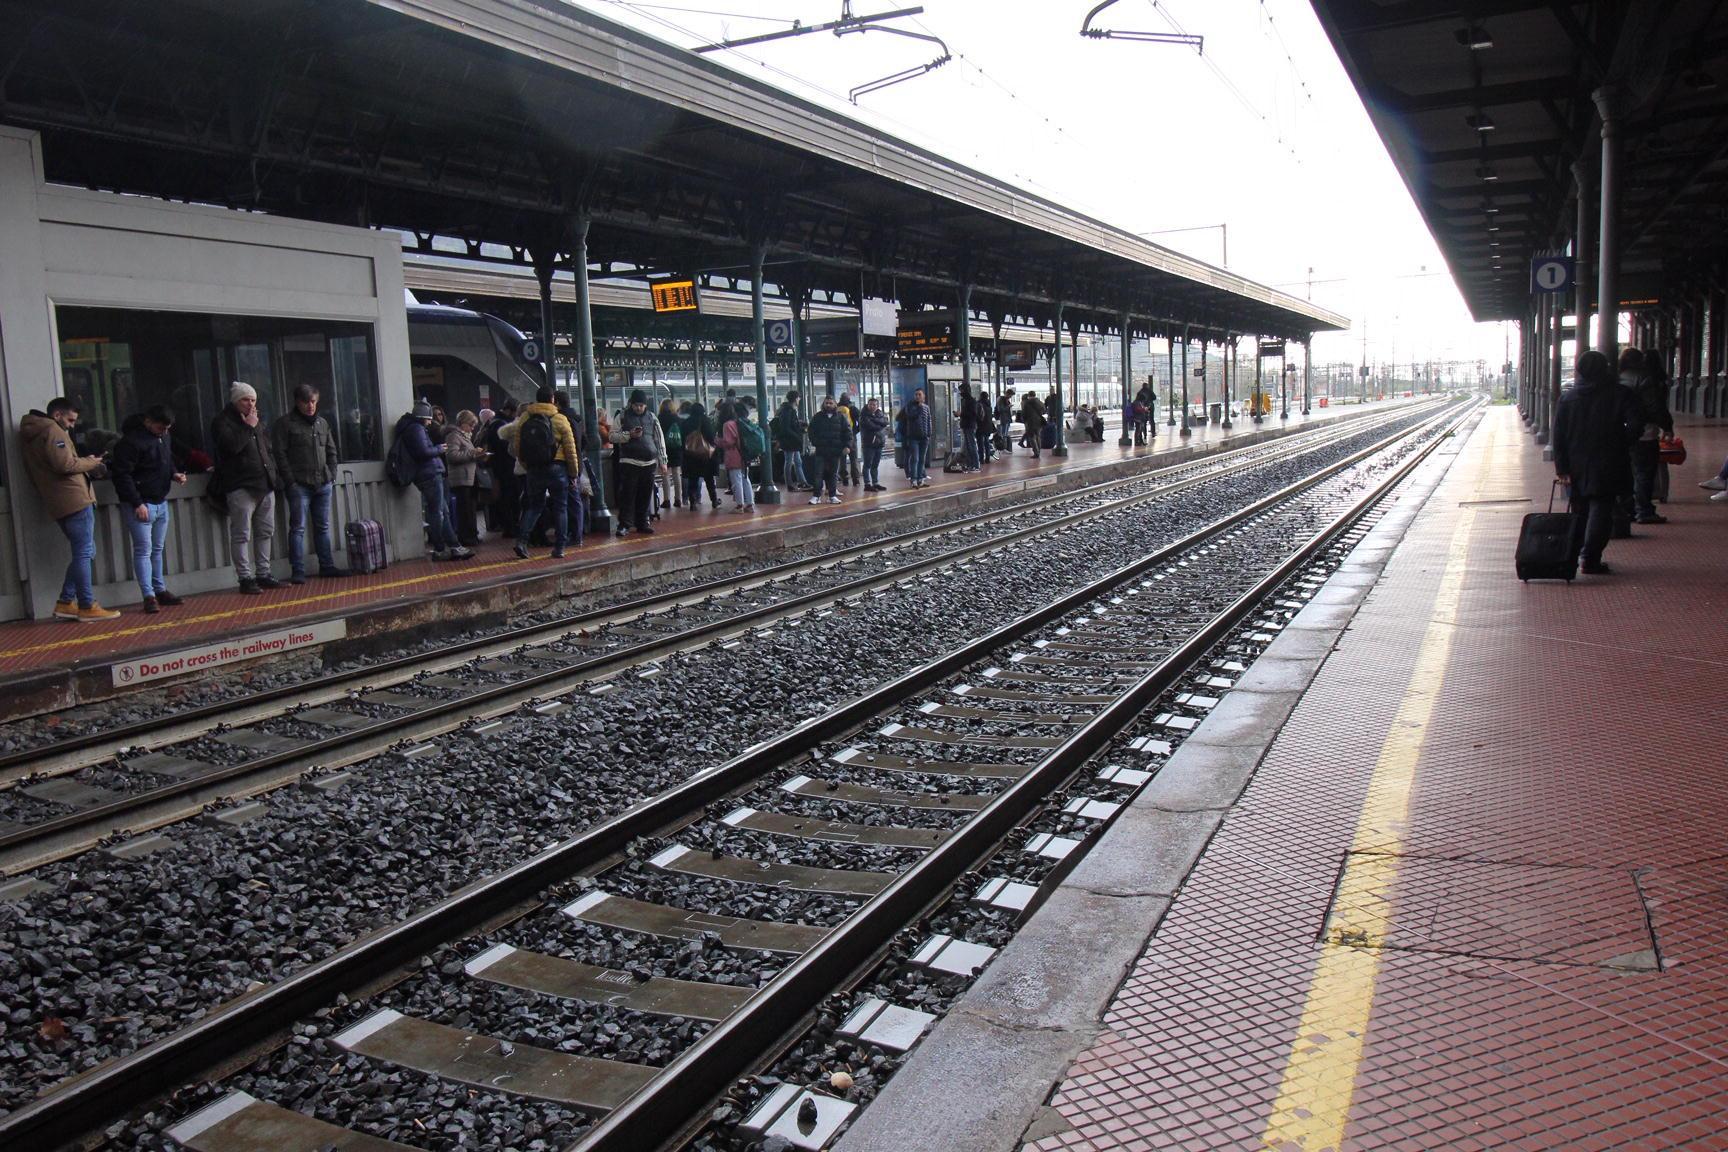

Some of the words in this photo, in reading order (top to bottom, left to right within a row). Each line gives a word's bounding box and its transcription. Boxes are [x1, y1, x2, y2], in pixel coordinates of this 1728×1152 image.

[1547, 267, 1556, 285] 1
[774, 326, 785, 340] 2
[944, 326, 951, 334] 2
[527, 344, 536, 358] 3
[140, 664, 159, 677] Do
[162, 658, 184, 671] not
[187, 653, 217, 667] cross
[219, 647, 240, 660] the
[242, 637, 286, 656] railway
[289, 632, 314, 645] lines
